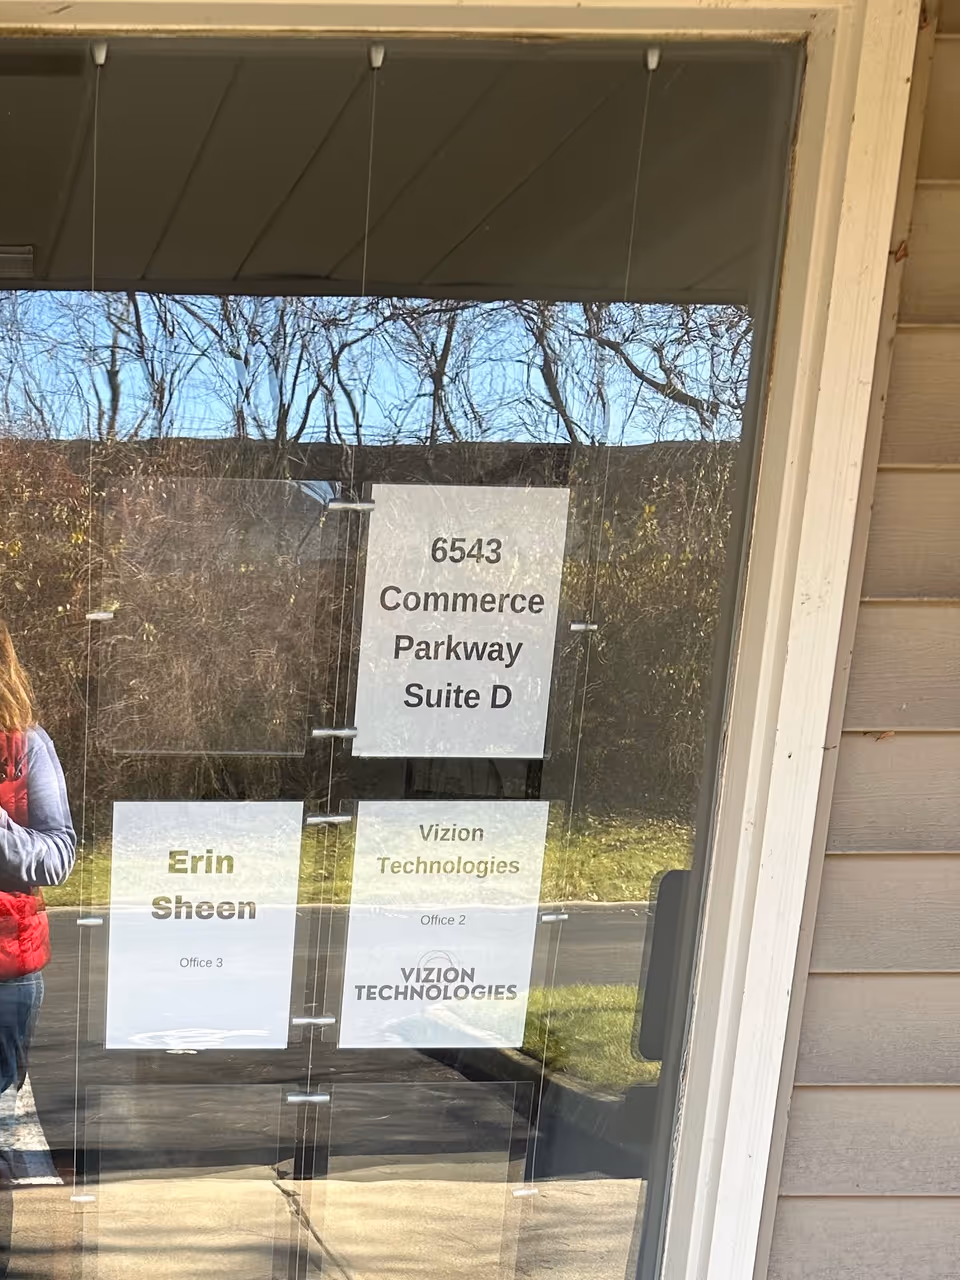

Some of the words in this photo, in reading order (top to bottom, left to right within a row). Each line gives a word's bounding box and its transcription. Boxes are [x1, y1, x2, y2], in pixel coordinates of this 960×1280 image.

[430, 537, 503, 564] 6543
[379, 585, 545, 614] Commerce
[393, 634, 524, 669] Parkway
[403, 682, 481, 709] Suite
[490, 684, 513, 709] D
[419, 823, 484, 842] Vizion
[167, 849, 234, 874] Erin
[376, 856, 520, 879] Technologies
[151, 895, 256, 920] Sheen
[420, 914, 455, 926] Office
[458, 914, 466, 926] 2
[179, 957, 213, 968] Office
[215, 957, 224, 968] 3
[400, 967, 475, 983] VIZION
[354, 984, 518, 1001] TECHNOLOGIES
